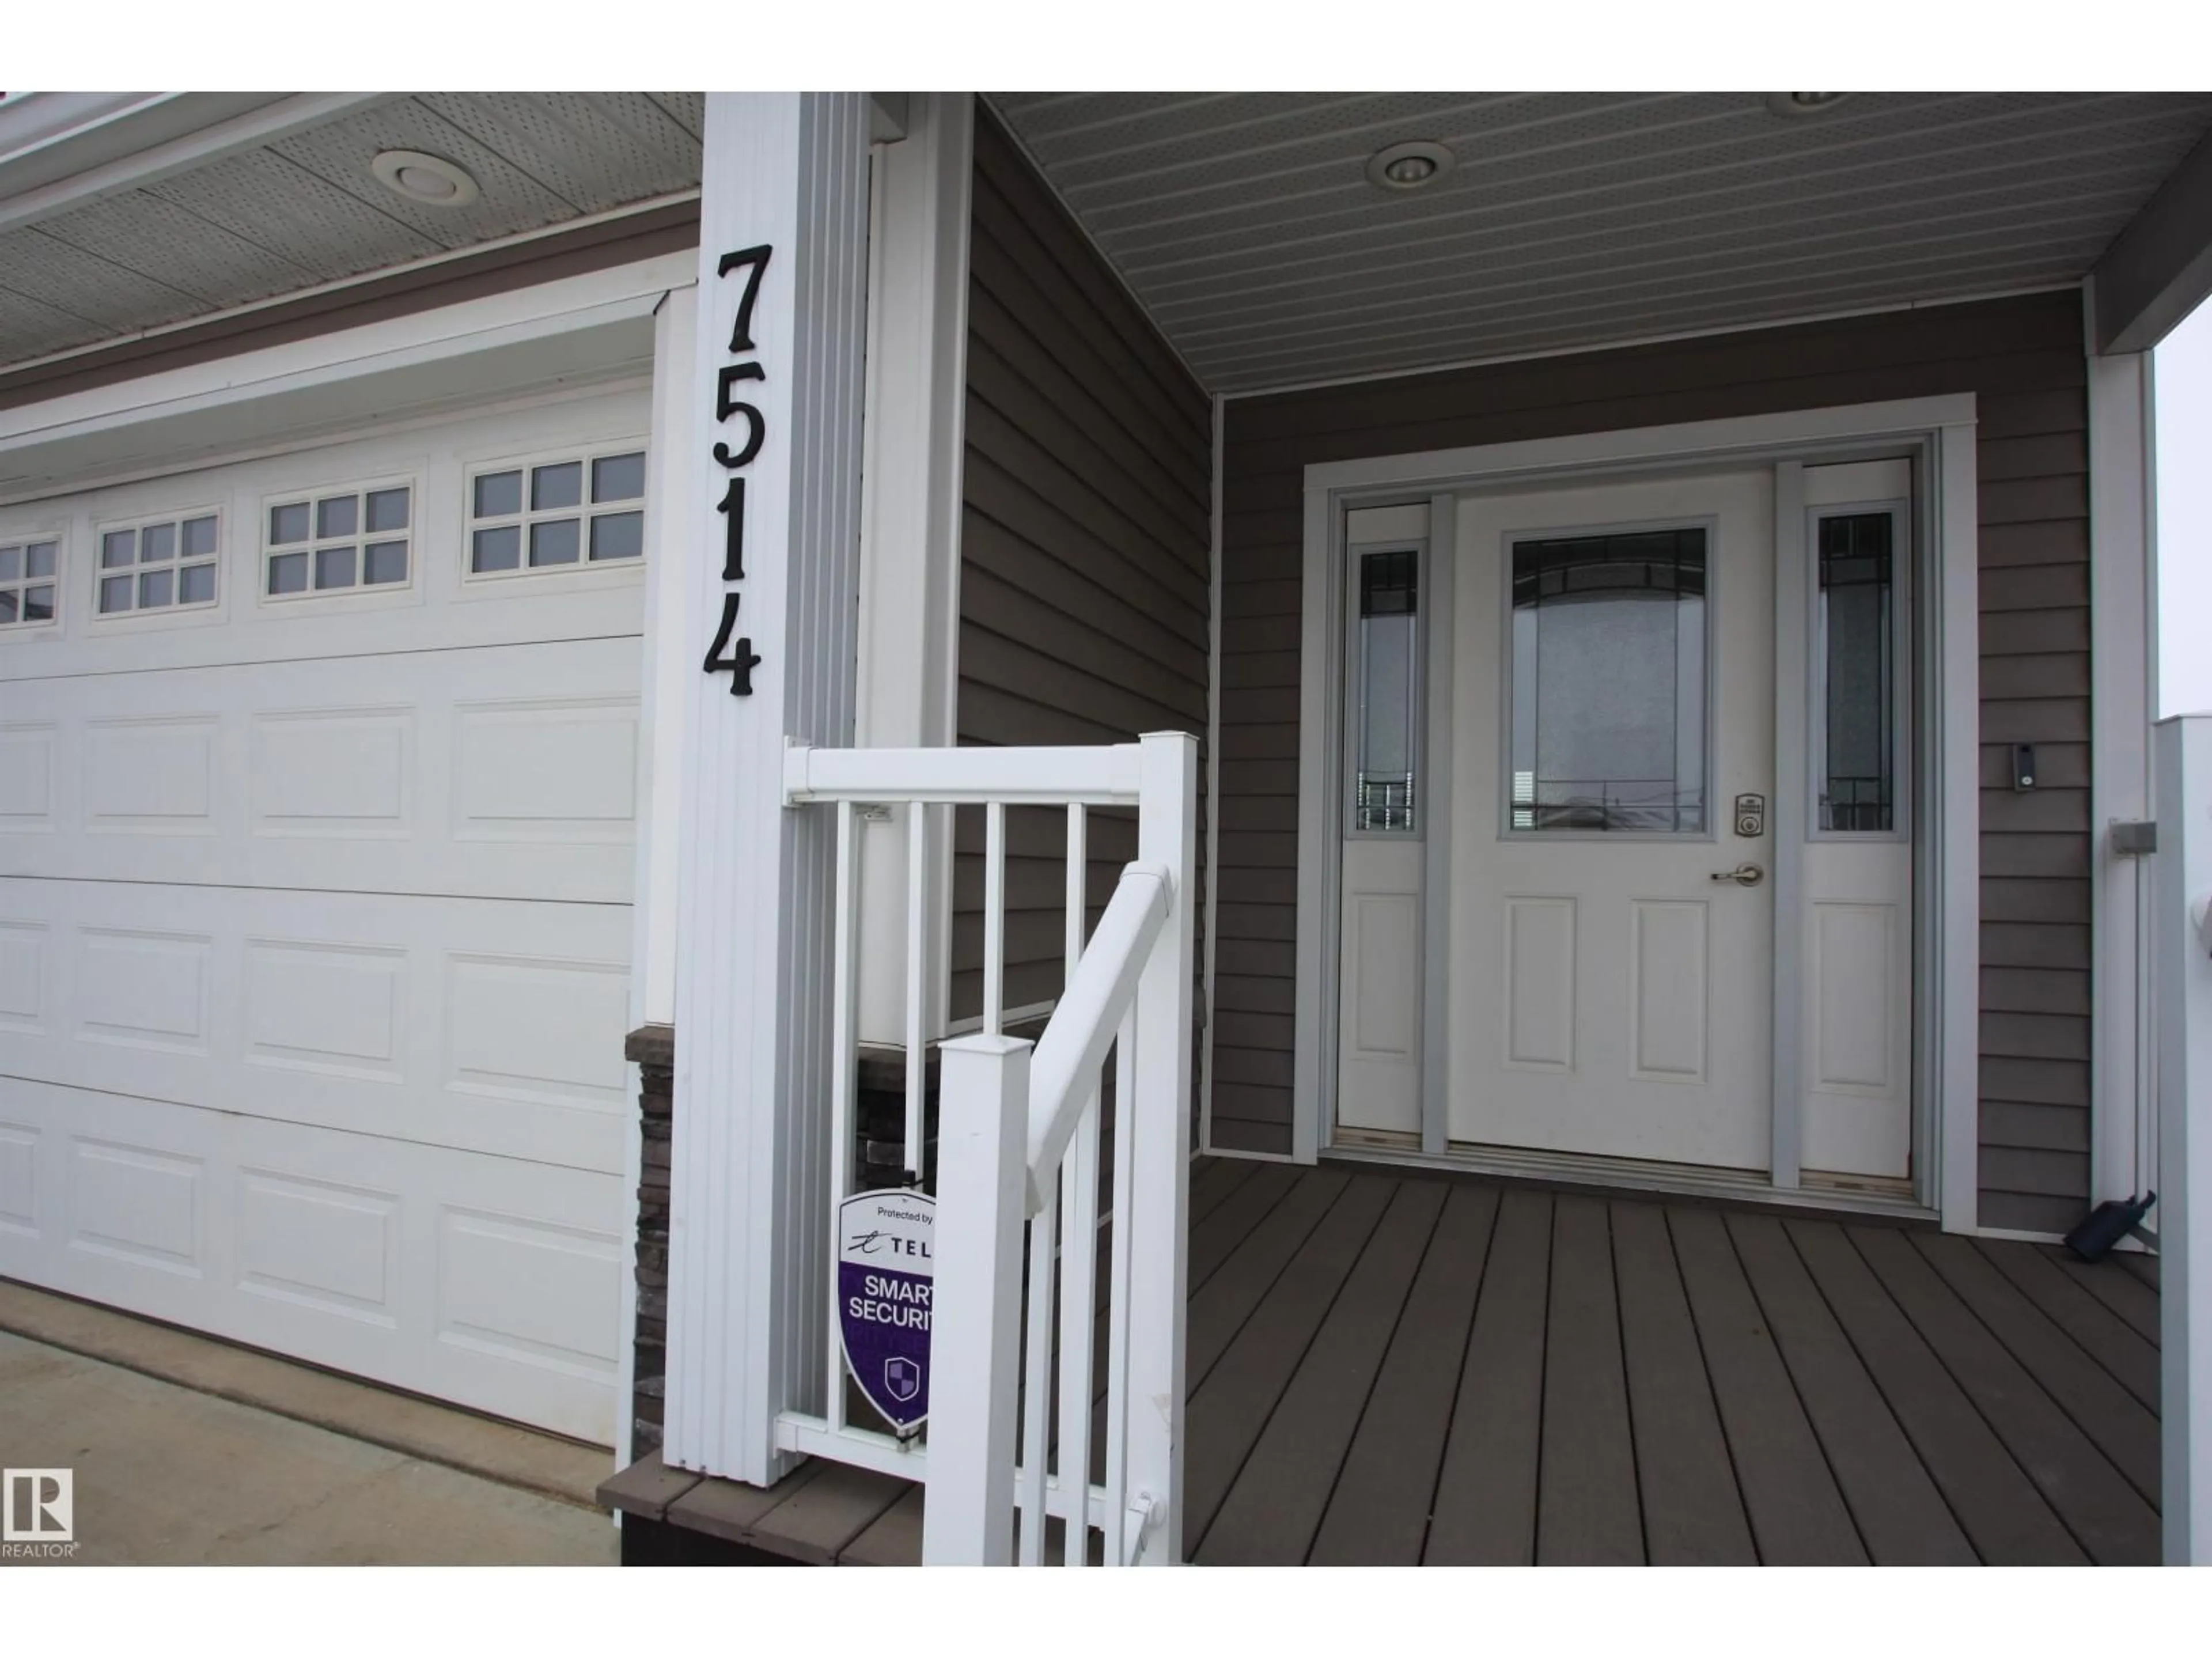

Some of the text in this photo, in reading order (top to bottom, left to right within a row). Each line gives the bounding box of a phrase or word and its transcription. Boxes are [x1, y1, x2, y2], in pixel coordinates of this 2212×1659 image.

[703, 244, 772, 696] 7514
[877, 1206, 933, 1225] Protected by
[849, 1296, 933, 1331] SECURI
